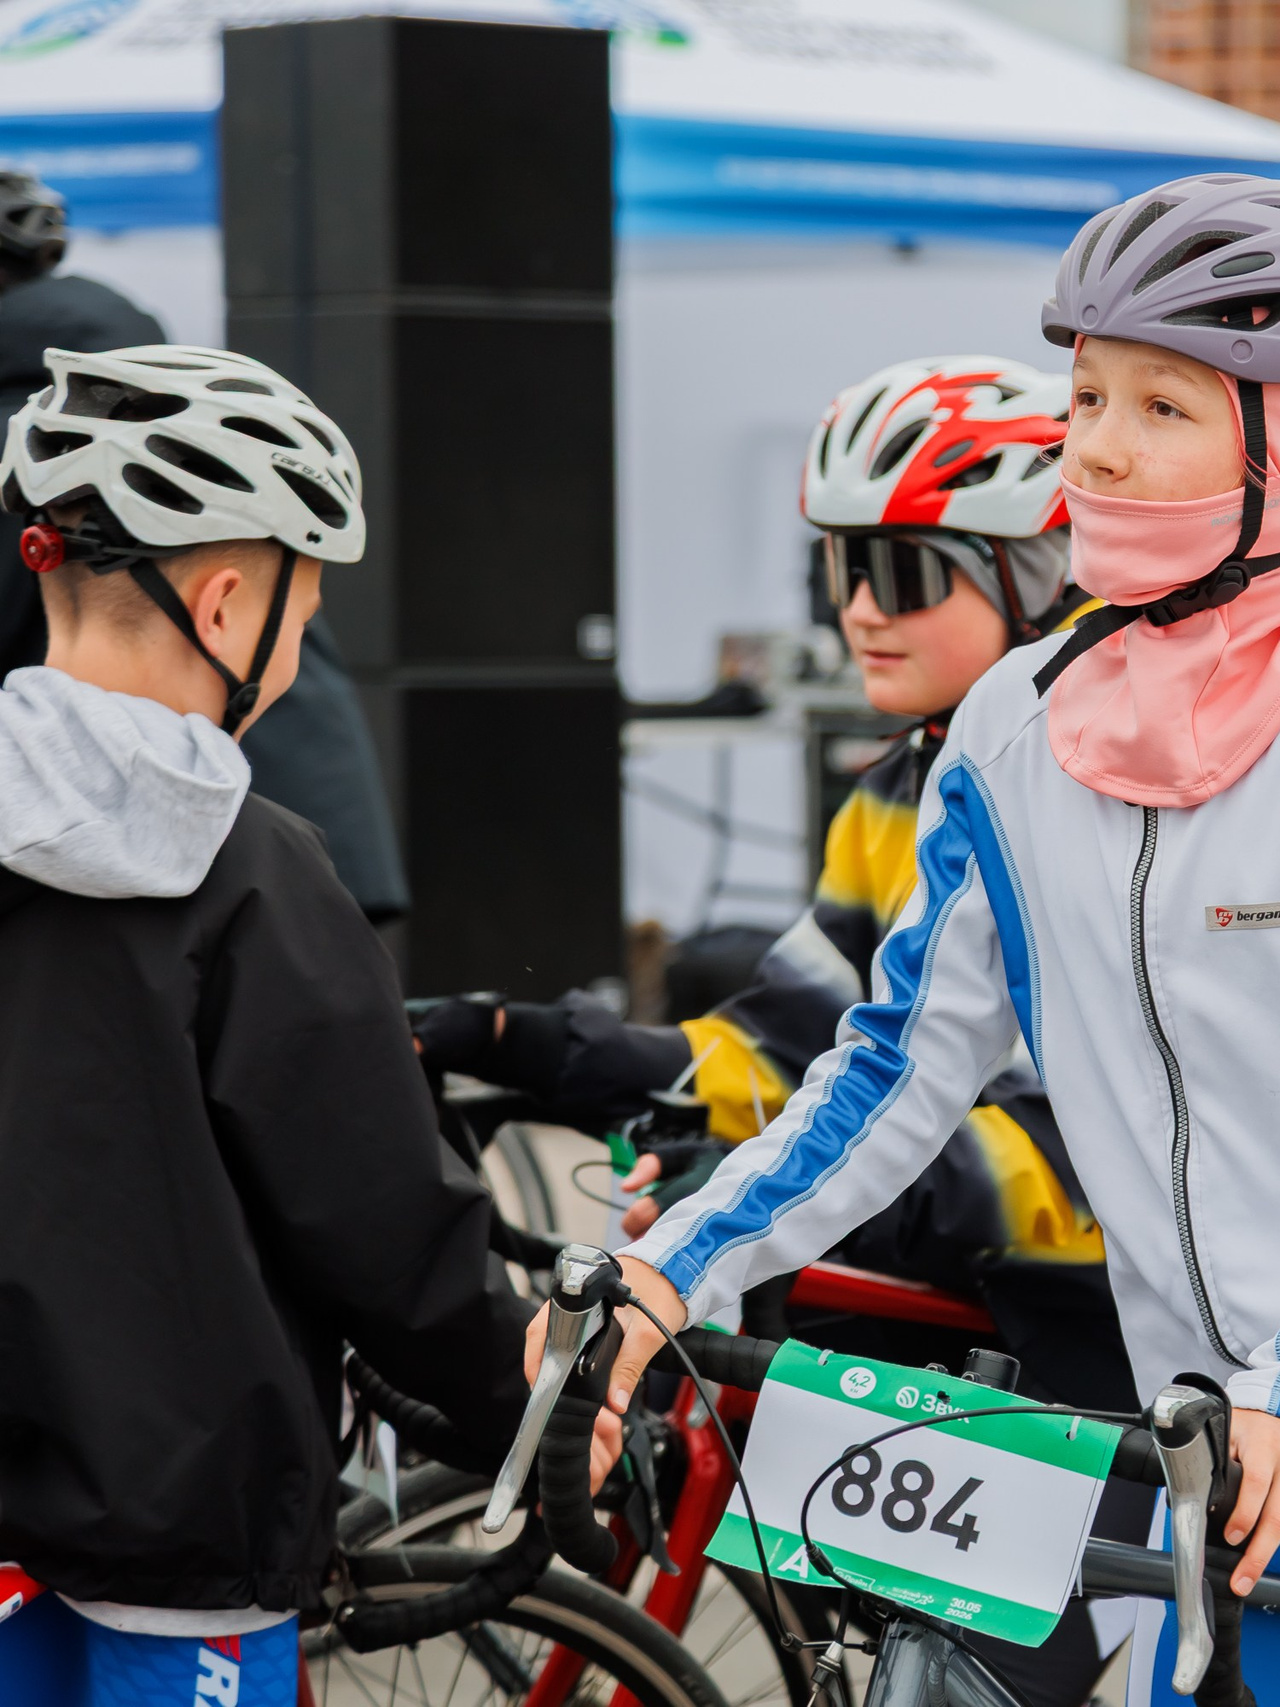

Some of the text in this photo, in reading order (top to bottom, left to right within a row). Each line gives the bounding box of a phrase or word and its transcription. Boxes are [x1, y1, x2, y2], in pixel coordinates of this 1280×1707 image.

[848, 1372, 871, 1389] 4,2
[832, 1444, 985, 1552] 884
[949, 1597, 982, 1614] 30.05
